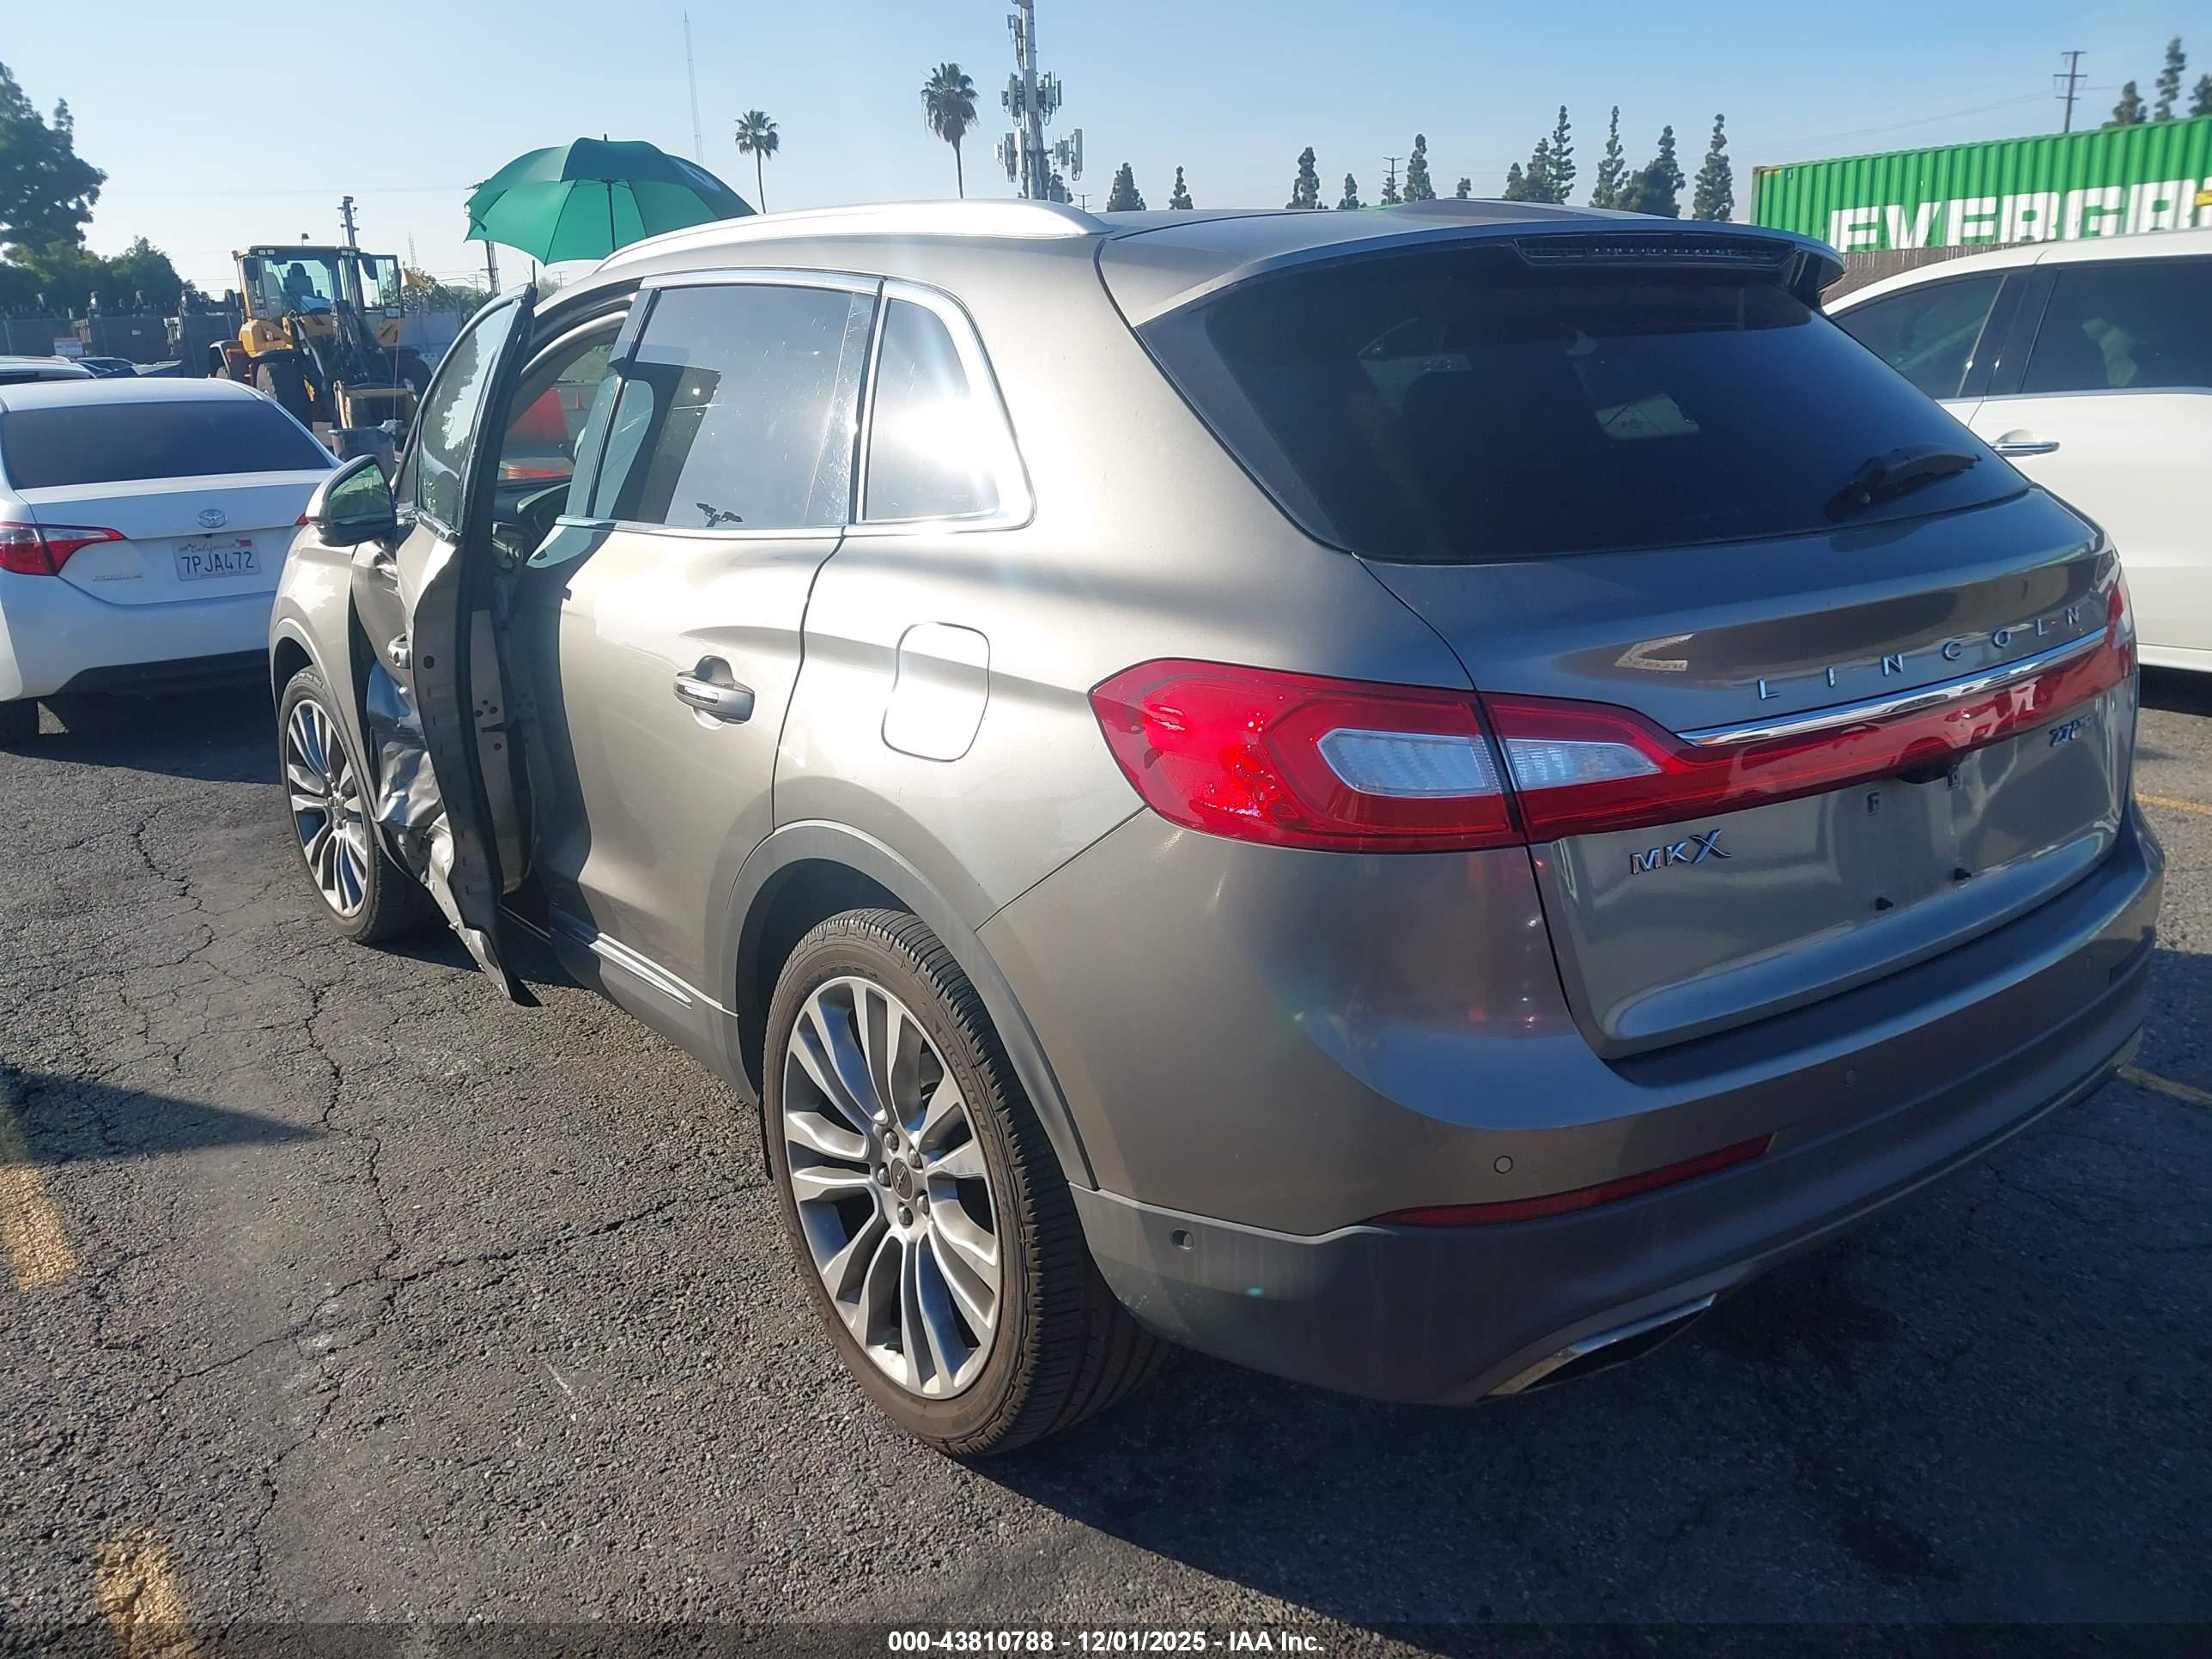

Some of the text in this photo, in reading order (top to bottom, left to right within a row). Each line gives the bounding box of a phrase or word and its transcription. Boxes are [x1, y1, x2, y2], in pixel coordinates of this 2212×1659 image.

[1830, 177, 2212, 254] EVERGR
[180, 551, 254, 574] 7PJA472
[1757, 605, 2080, 701] LINCOLN
[1630, 829, 1731, 875] MKX
